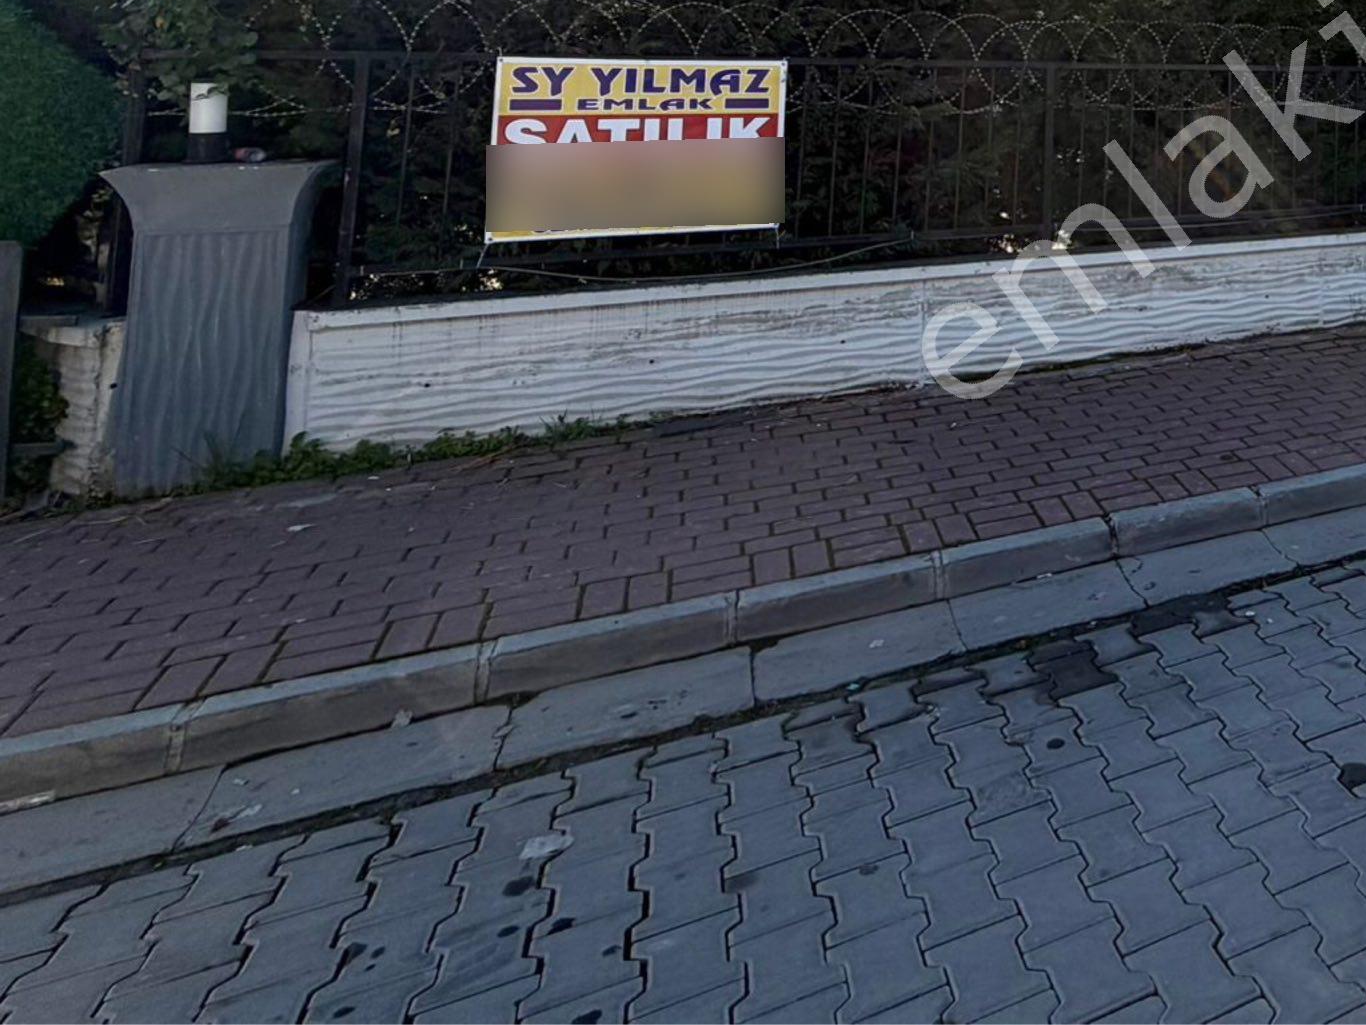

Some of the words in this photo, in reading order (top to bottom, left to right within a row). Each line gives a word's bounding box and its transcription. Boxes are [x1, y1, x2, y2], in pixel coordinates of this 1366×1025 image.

[511, 66, 575, 97] SY
[591, 67, 771, 97] YILMAZ
[576, 98, 713, 112] EMLAK
